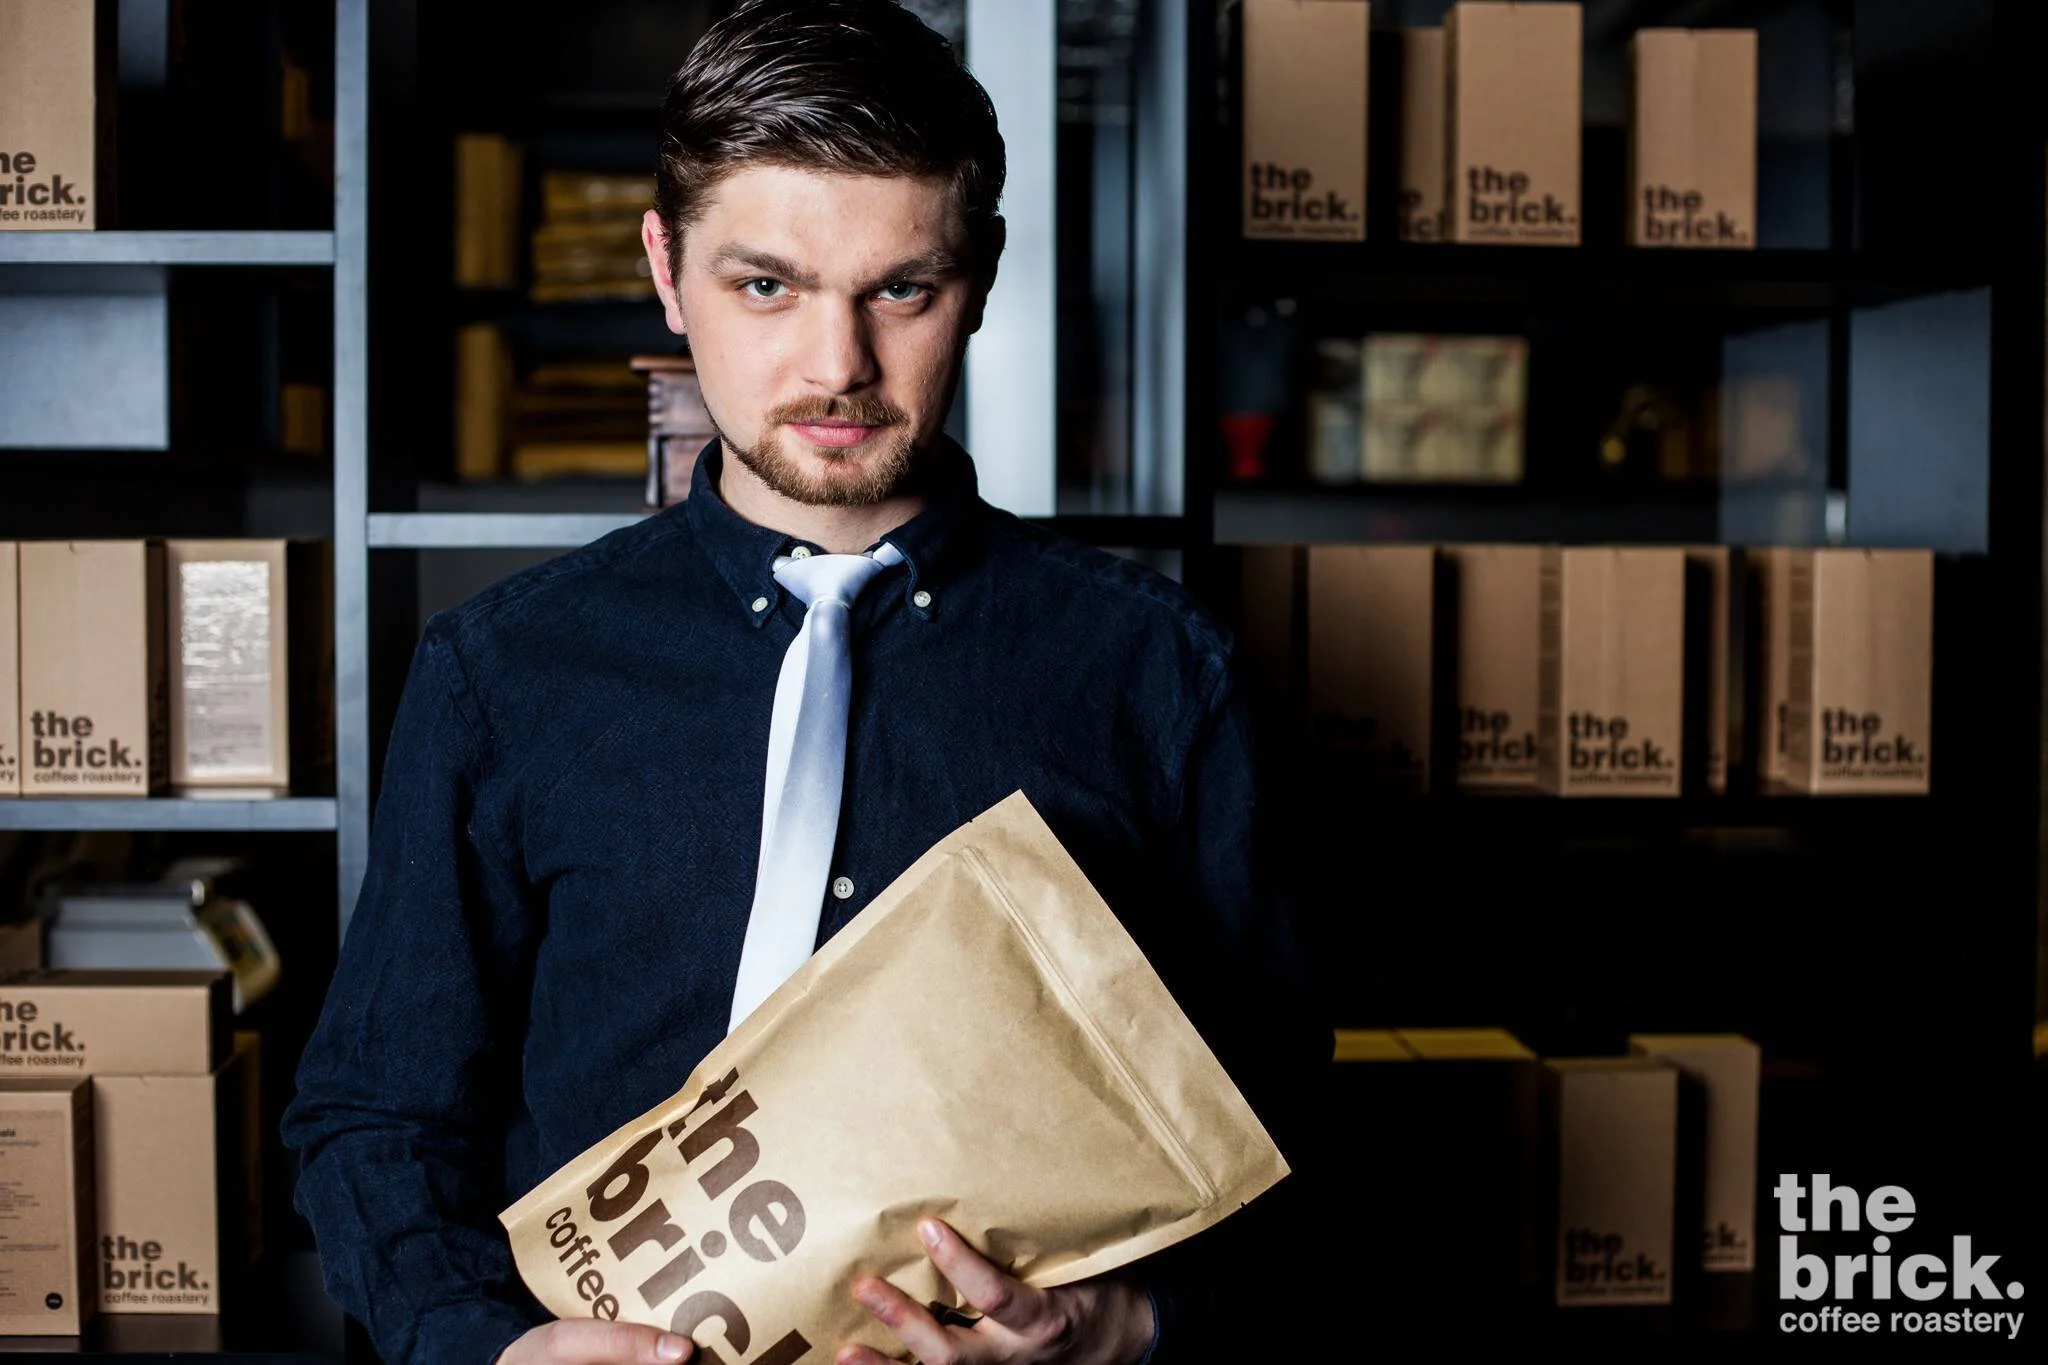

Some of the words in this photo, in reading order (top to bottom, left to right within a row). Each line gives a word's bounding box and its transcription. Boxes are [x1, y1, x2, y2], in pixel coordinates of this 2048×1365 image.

[0, 174, 86, 206] rick.
[1251, 163, 1311, 191] the
[1467, 167, 1529, 194] the
[1251, 191, 1359, 220] brick.
[1469, 195, 1577, 224] brick.
[1645, 186, 1703, 211] the
[24, 209, 86, 223] roastery
[1646, 211, 1748, 241] brick.
[30, 711, 93, 737] the
[1567, 713, 1628, 741] the
[1822, 707, 1881, 735] the
[34, 739, 142, 768] brick.
[1569, 740, 1674, 769] brick.
[1823, 736, 1924, 764] brick.
[34, 771, 78, 784] coffee
[82, 771, 141, 786] roastery
[0, 1023, 86, 1052] rick.
[27, 1055, 84, 1068] roastery
[101, 1236, 162, 1260] the
[586, 1127, 812, 1365] bric
[1566, 1229, 1624, 1255] the
[104, 1261, 208, 1290] brick.
[545, 1206, 620, 1322] coffee
[1566, 1252, 1667, 1281] brick.
[104, 1292, 148, 1304] coffee
[152, 1293, 207, 1305] roastery
